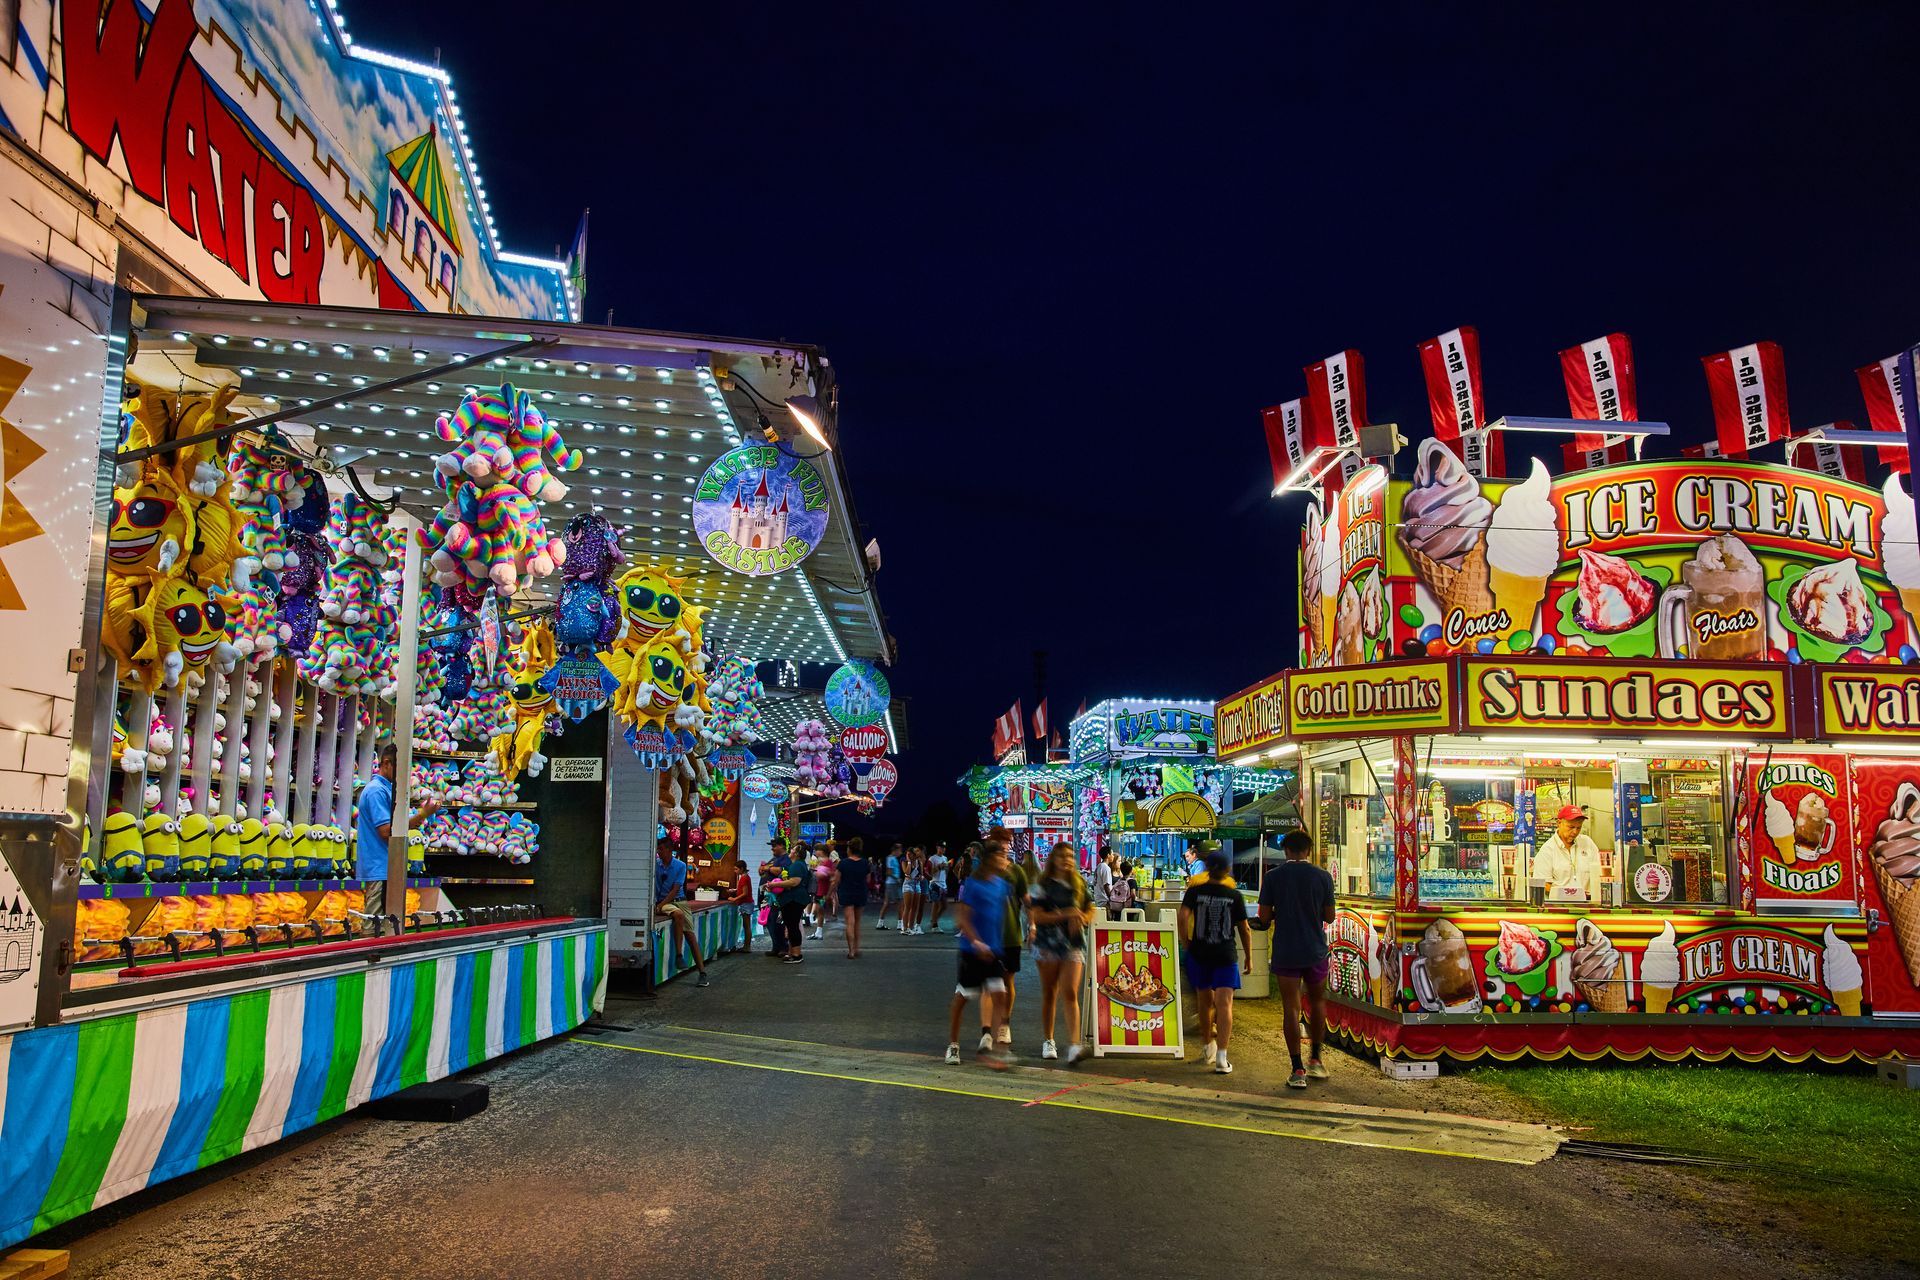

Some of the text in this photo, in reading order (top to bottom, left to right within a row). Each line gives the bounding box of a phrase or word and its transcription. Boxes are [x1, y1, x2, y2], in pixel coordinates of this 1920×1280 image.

[695, 446, 829, 513] WATER FUN
[1564, 475, 1876, 559] ICE CREAM
[705, 530, 810, 574] CASTLE
[1341, 520, 1383, 577] CREAM
[1445, 606, 1512, 647] Cones
[1693, 609, 1758, 641] Floats
[552, 689, 606, 700] CHOICE
[1296, 677, 1441, 716] Cold Drinks
[1482, 669, 1774, 724] Sundaes
[1220, 689, 1283, 748] Cones & Floats
[843, 732, 886, 750] BALLOONS
[563, 772, 594, 780] GANADOR
[868, 765, 896, 783] ALLOONS
[1674, 782, 1702, 791] Menu
[1758, 763, 1836, 796] Cones
[1265, 818, 1290, 827] Lemon
[1763, 858, 1840, 892] Floats
[1100, 940, 1170, 959] ICE CREAM
[1340, 915, 1367, 955] CREAM
[1684, 935, 1819, 986] ICE CREAM
[1111, 1015, 1164, 1032] NACHOS
